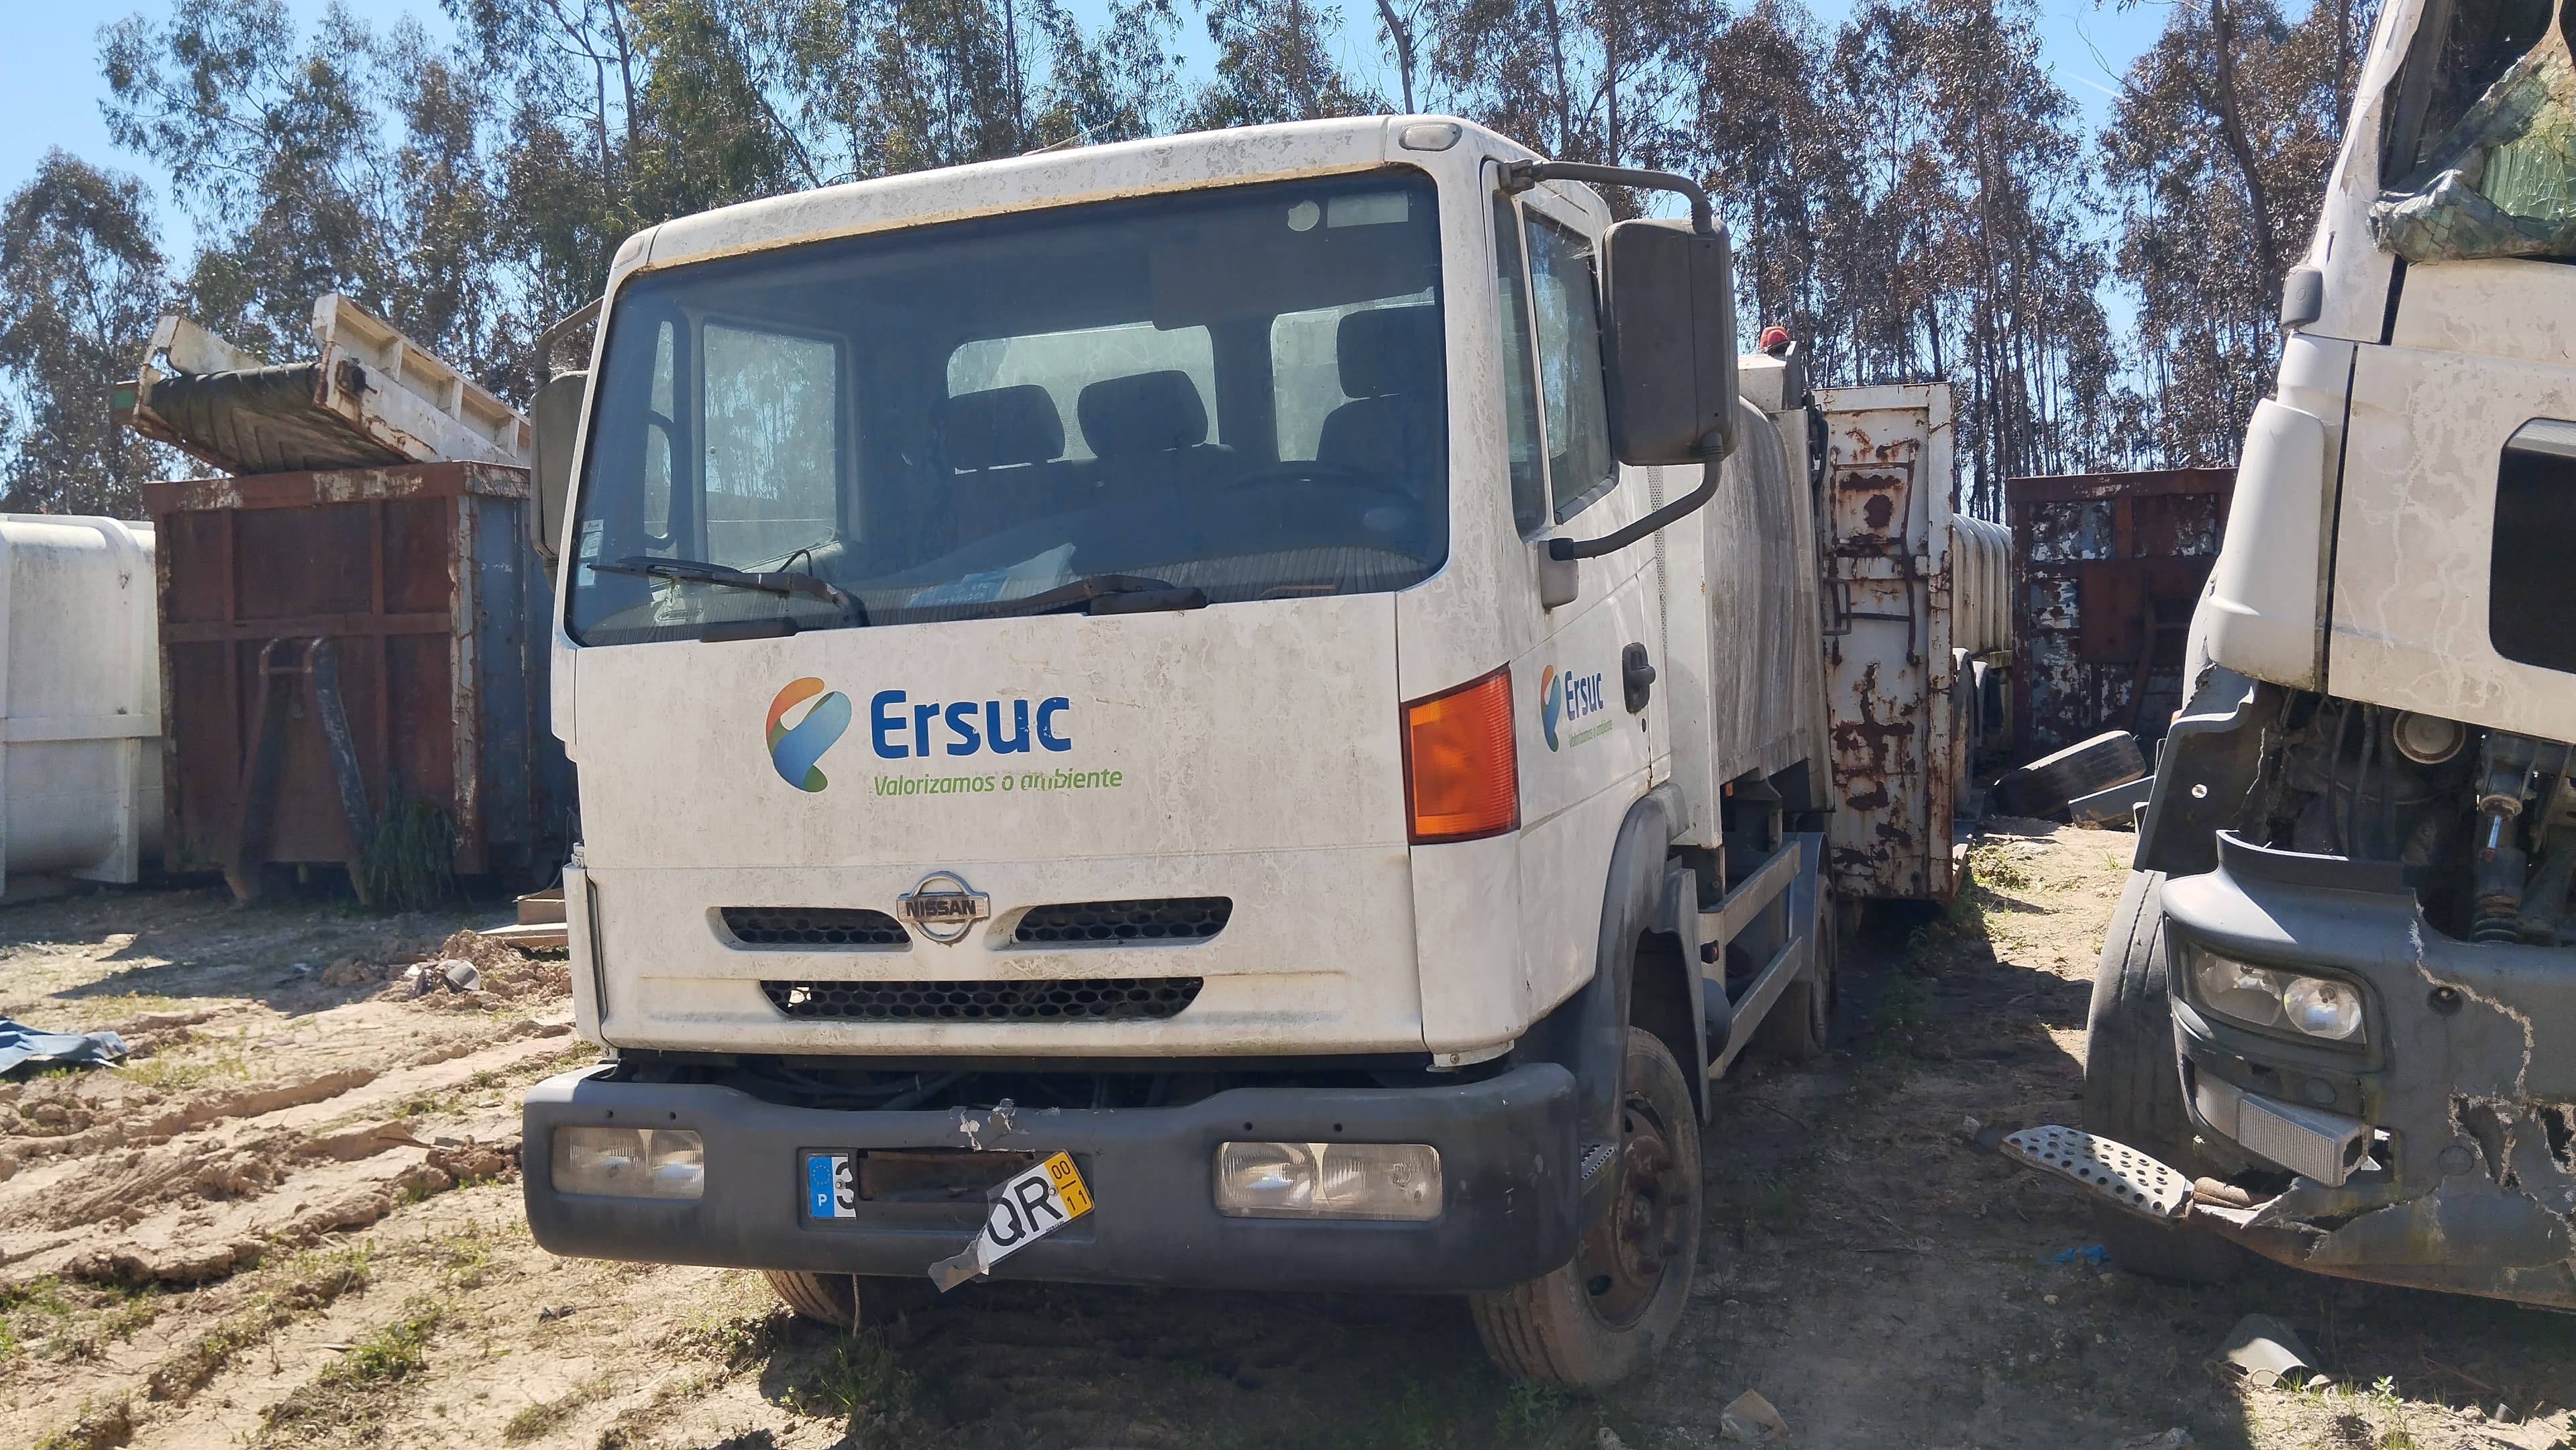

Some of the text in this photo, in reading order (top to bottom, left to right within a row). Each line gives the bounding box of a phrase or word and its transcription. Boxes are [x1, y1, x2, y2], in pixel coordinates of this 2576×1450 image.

[1564, 670, 1604, 721] Ersuc
[871, 690, 1071, 759] Ersuc
[874, 767, 1123, 796] Valorizamos o ambiente
[906, 899, 977, 917] NISSAN
[1051, 1160, 1071, 1180] 00
[817, 1193, 828, 1206] P
[986, 1176, 1064, 1247] QR
